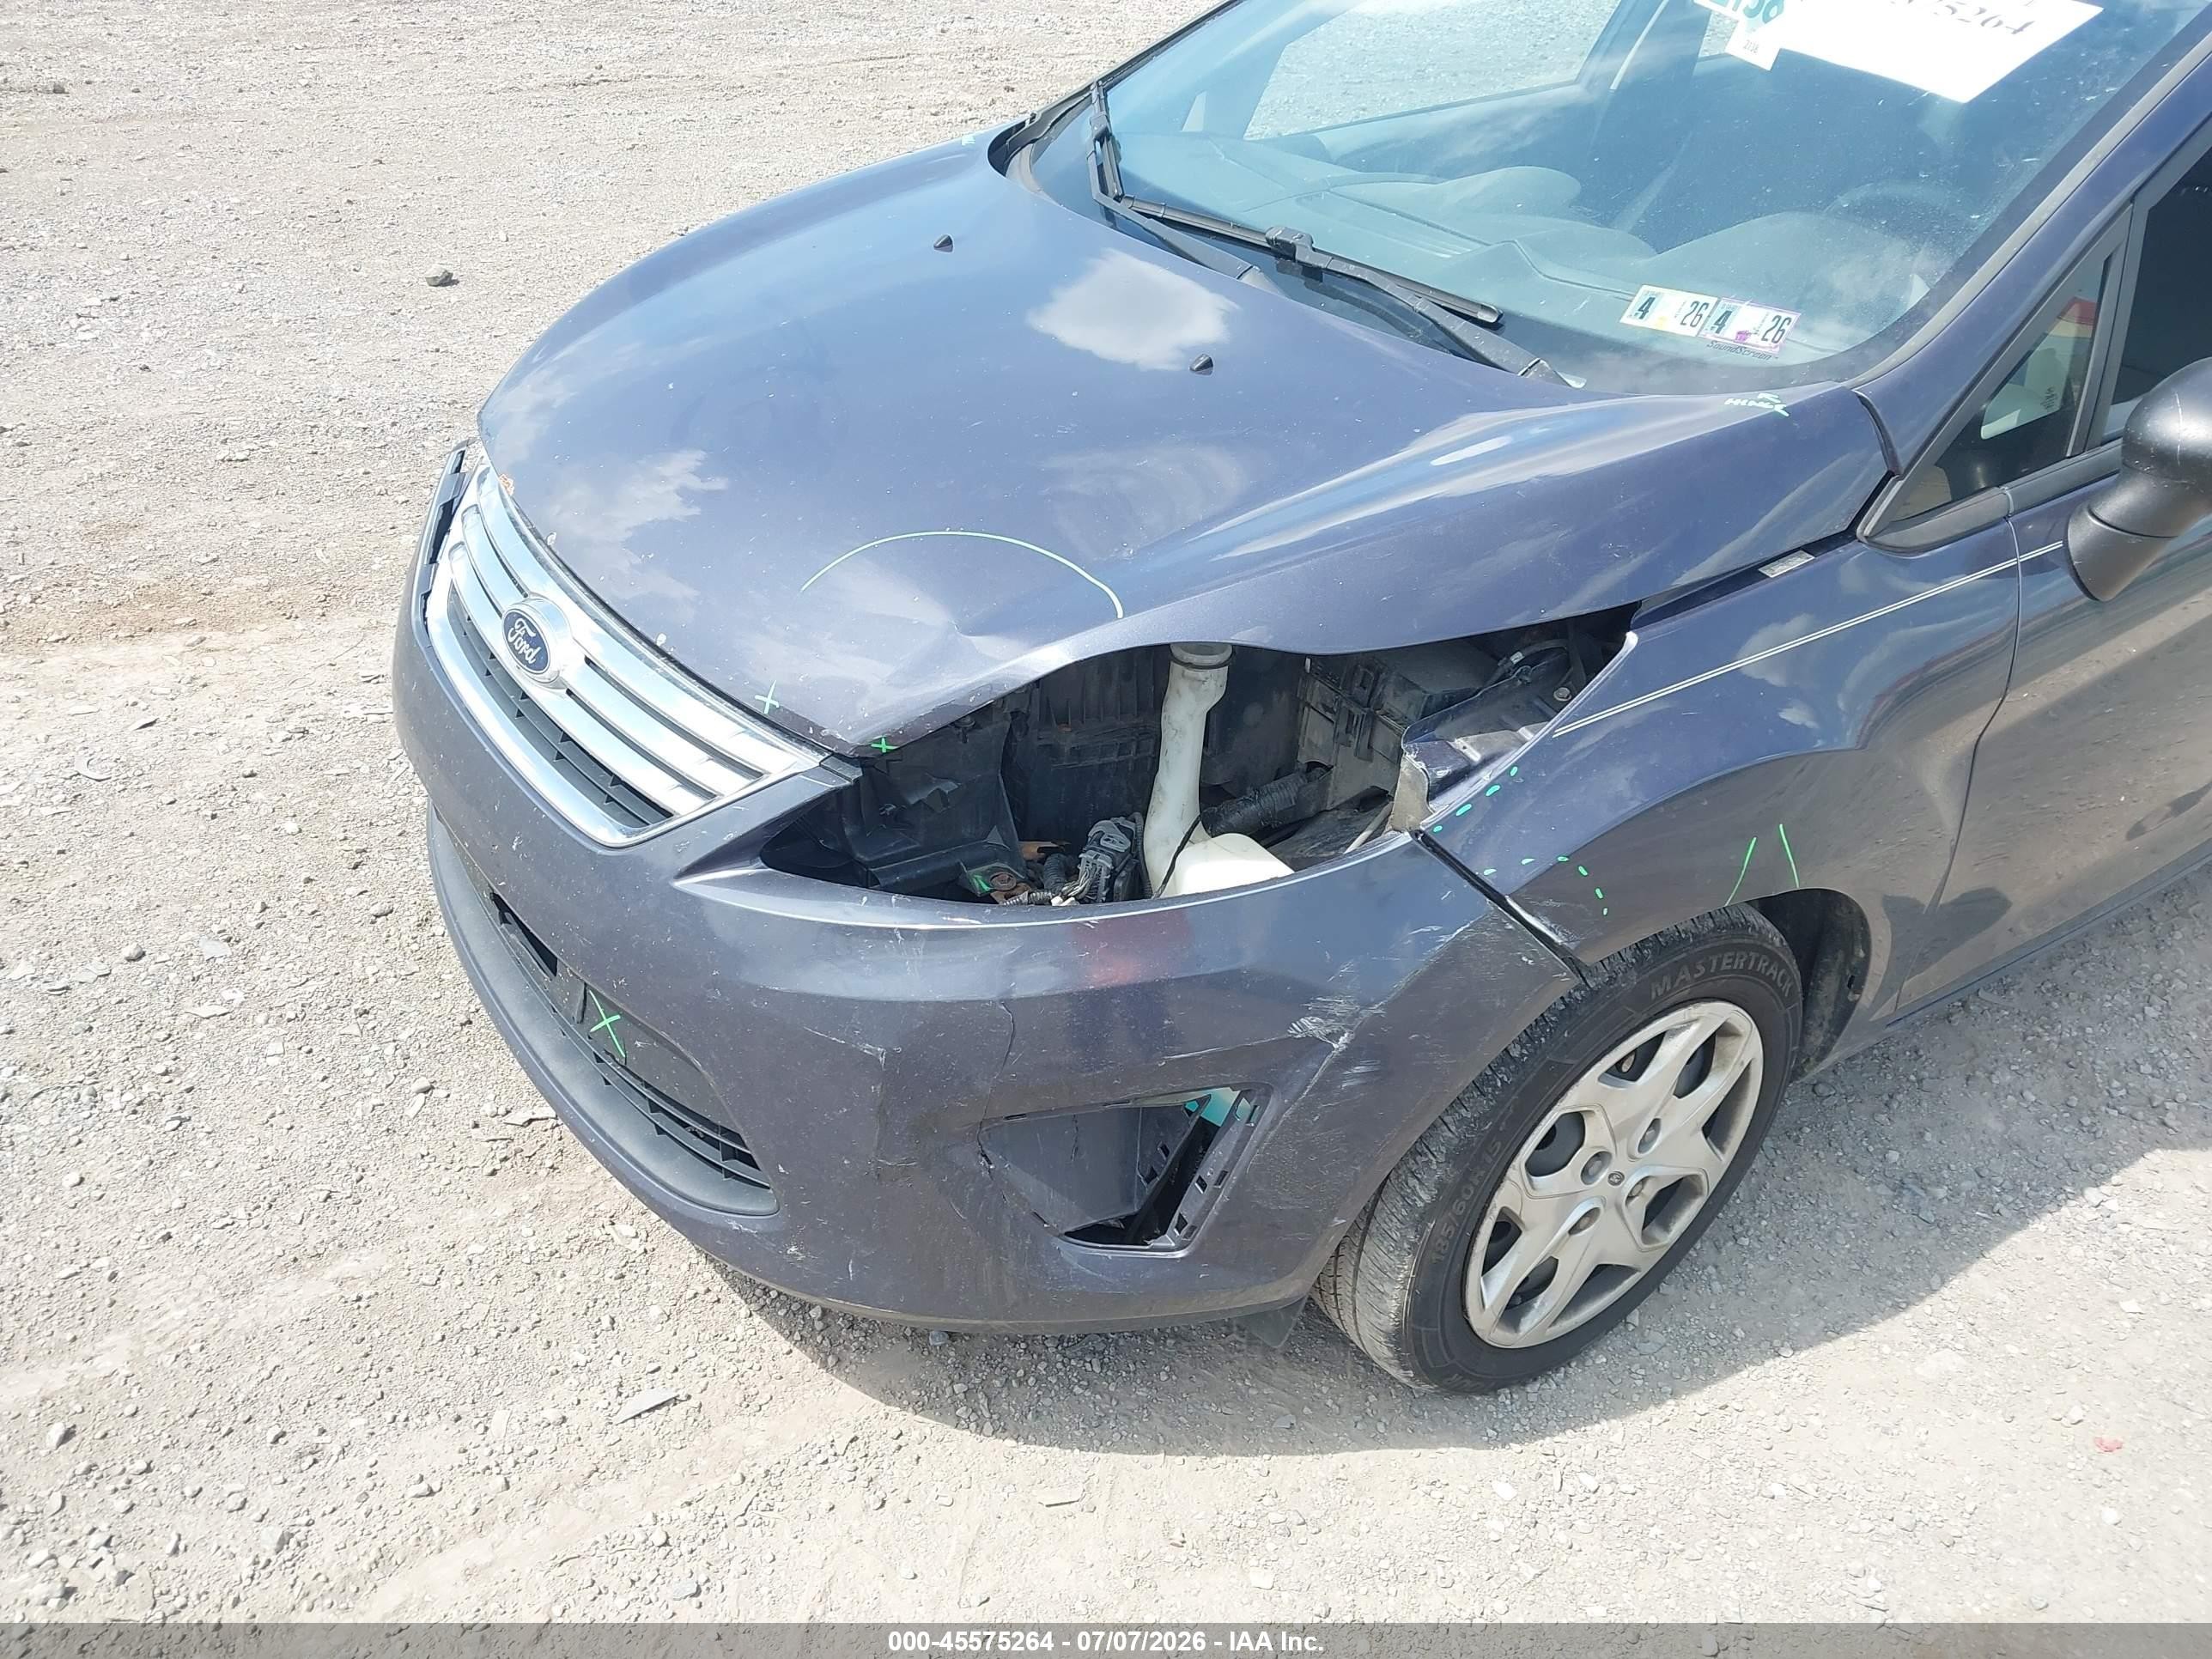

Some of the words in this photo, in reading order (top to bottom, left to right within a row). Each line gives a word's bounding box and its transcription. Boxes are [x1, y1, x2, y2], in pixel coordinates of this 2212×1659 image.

[1634, 296, 1656, 319] 4
[1680, 301, 1710, 328] 26
[1710, 309, 1733, 334] 4
[1760, 314, 1792, 344] 26
[507, 617, 542, 664] Ford
[1650, 951, 1793, 1000] MASTERTRACK
